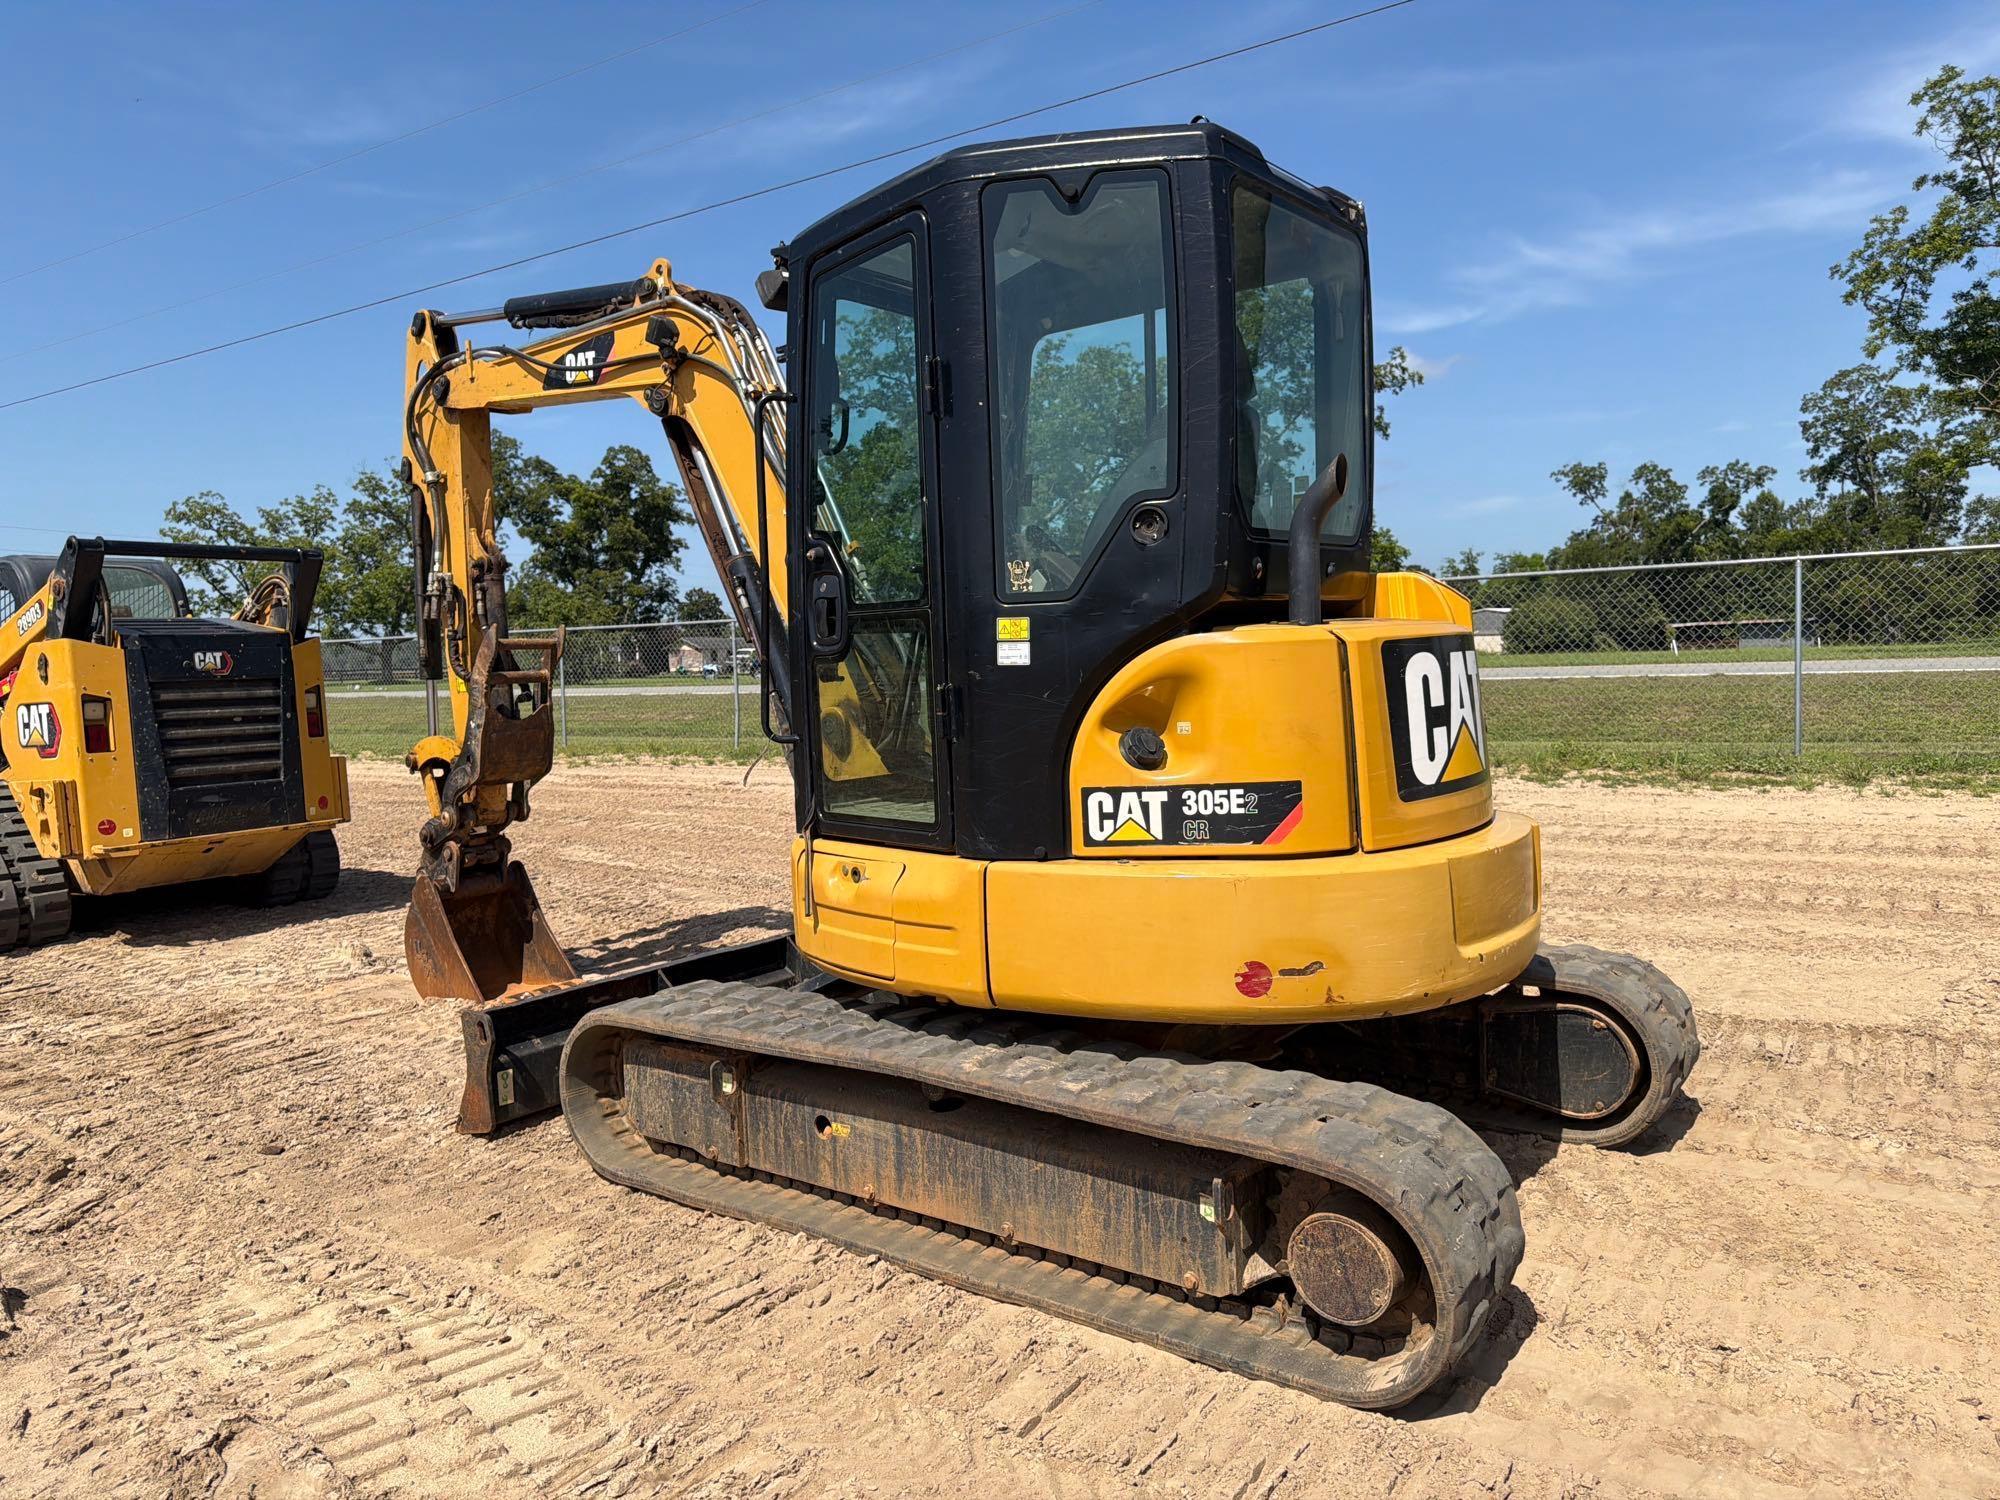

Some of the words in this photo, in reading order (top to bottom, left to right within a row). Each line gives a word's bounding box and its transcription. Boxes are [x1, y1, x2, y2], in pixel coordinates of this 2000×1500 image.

[565, 350, 596, 385] CAT
[194, 651, 223, 671] CAT
[17, 704, 50, 747] CAT
[1405, 650, 1487, 786] CAT
[1087, 790, 1169, 842] CAT
[1181, 788, 1259, 816] 305E2
[1182, 819, 1210, 840] CR
